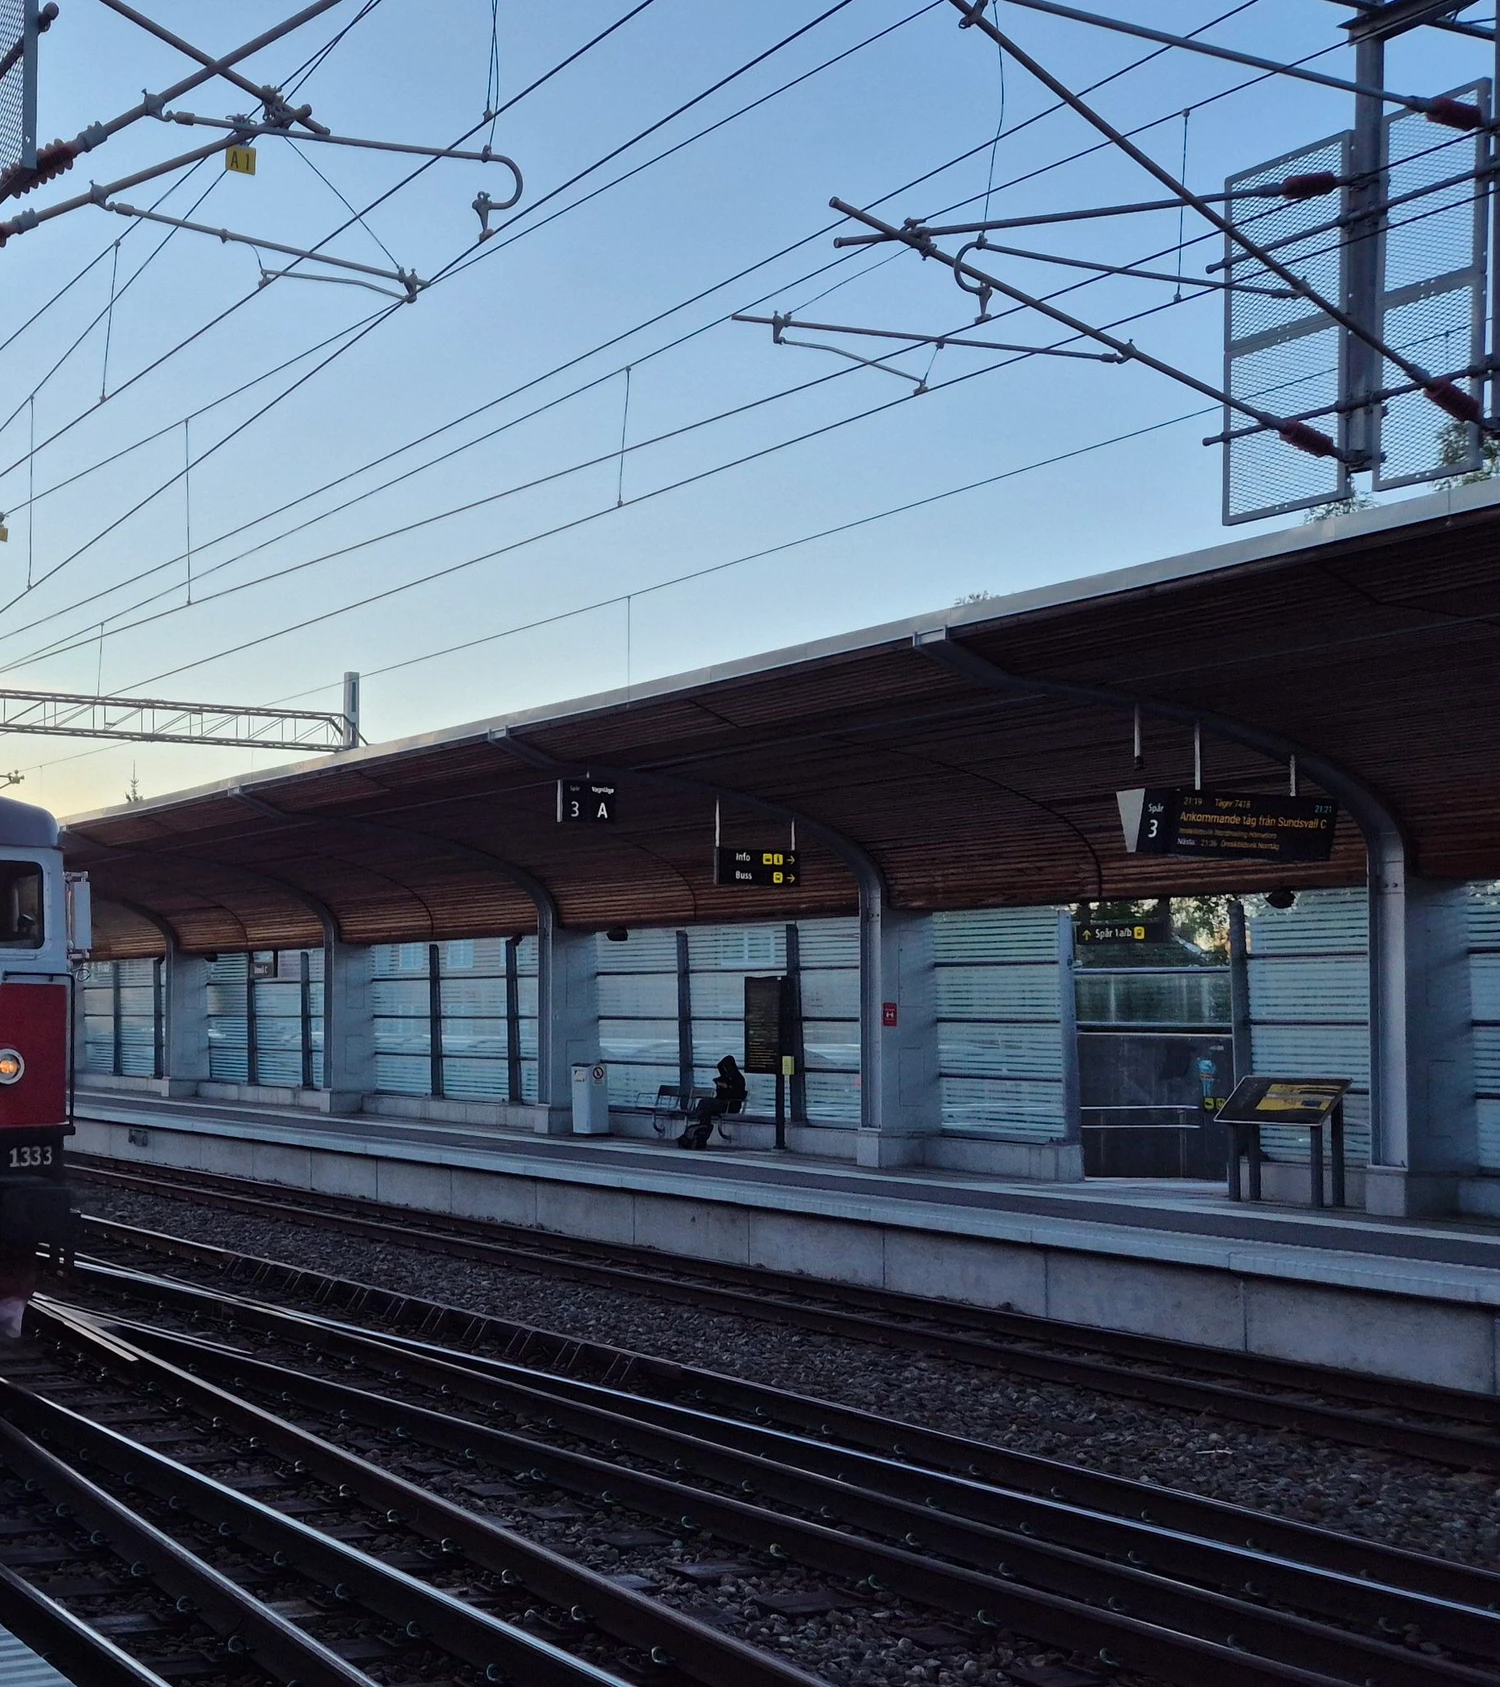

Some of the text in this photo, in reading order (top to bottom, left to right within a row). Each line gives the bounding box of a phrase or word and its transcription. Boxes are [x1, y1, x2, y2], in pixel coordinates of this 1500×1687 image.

[230, 150, 239, 169] A
[571, 801, 579, 817] 3
[597, 802, 608, 819] A
[1148, 803, 1164, 814] Spår
[1180, 811, 1327, 829] Ankommande tåg från Sundsvall C
[1147, 819, 1158, 838] 3
[735, 852, 751, 862] Info
[735, 871, 753, 880] Buss
[1095, 928, 1113, 940] Spår
[9, 1146, 52, 1168] 1333
